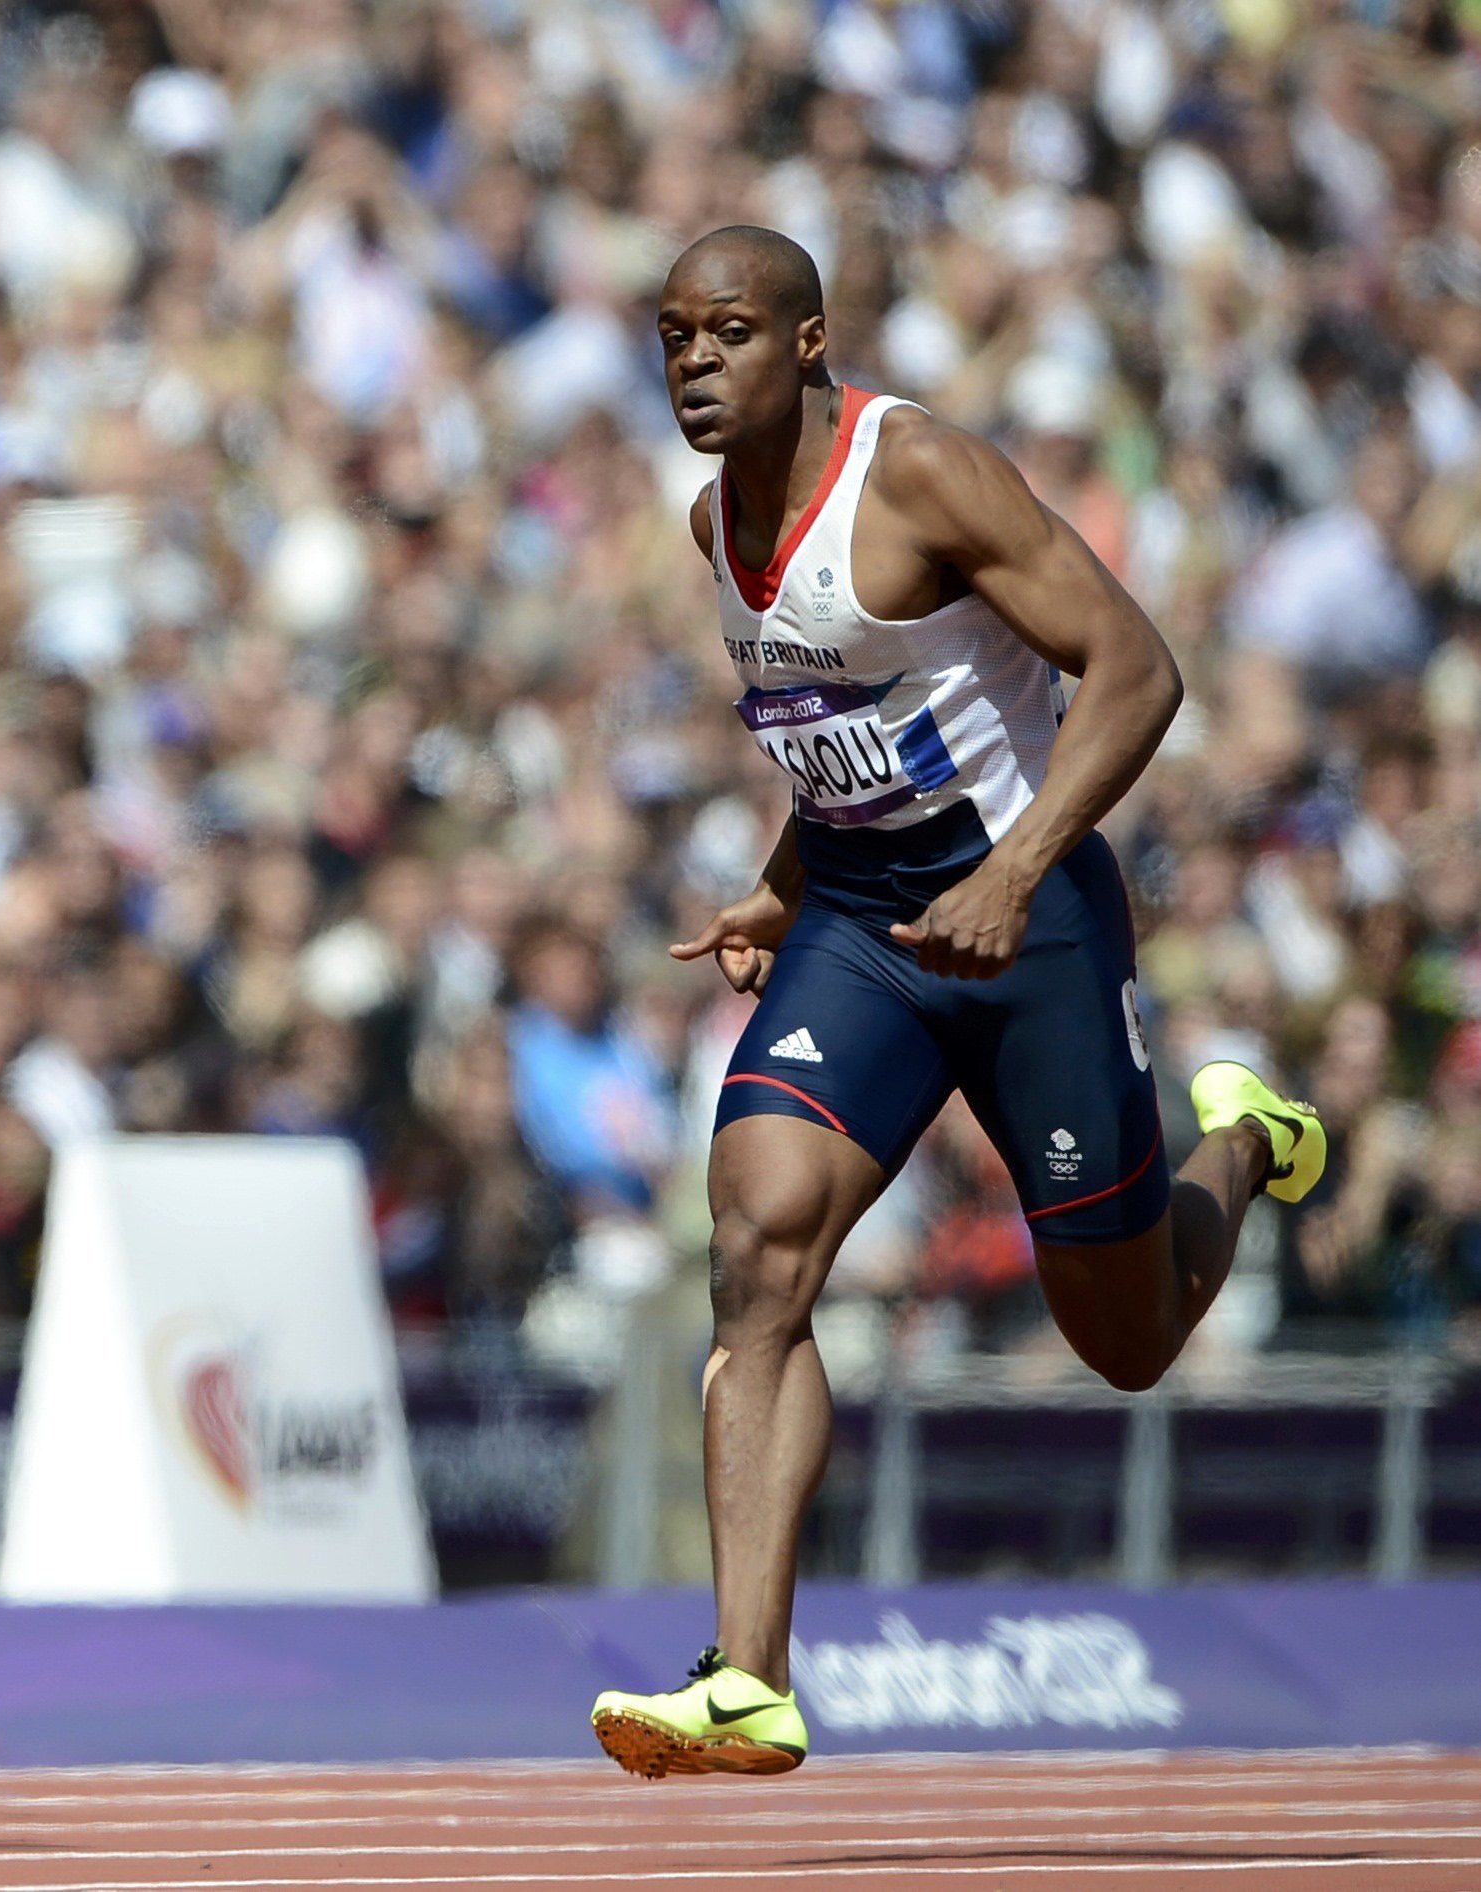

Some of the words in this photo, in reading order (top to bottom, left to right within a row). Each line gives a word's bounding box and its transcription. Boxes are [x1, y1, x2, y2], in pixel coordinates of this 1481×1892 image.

[761, 641, 845, 670] BRITAIN
[793, 697, 823, 720] 2012
[769, 1045, 823, 1063] adidas
[1045, 1151, 1068, 1160] TEAM
